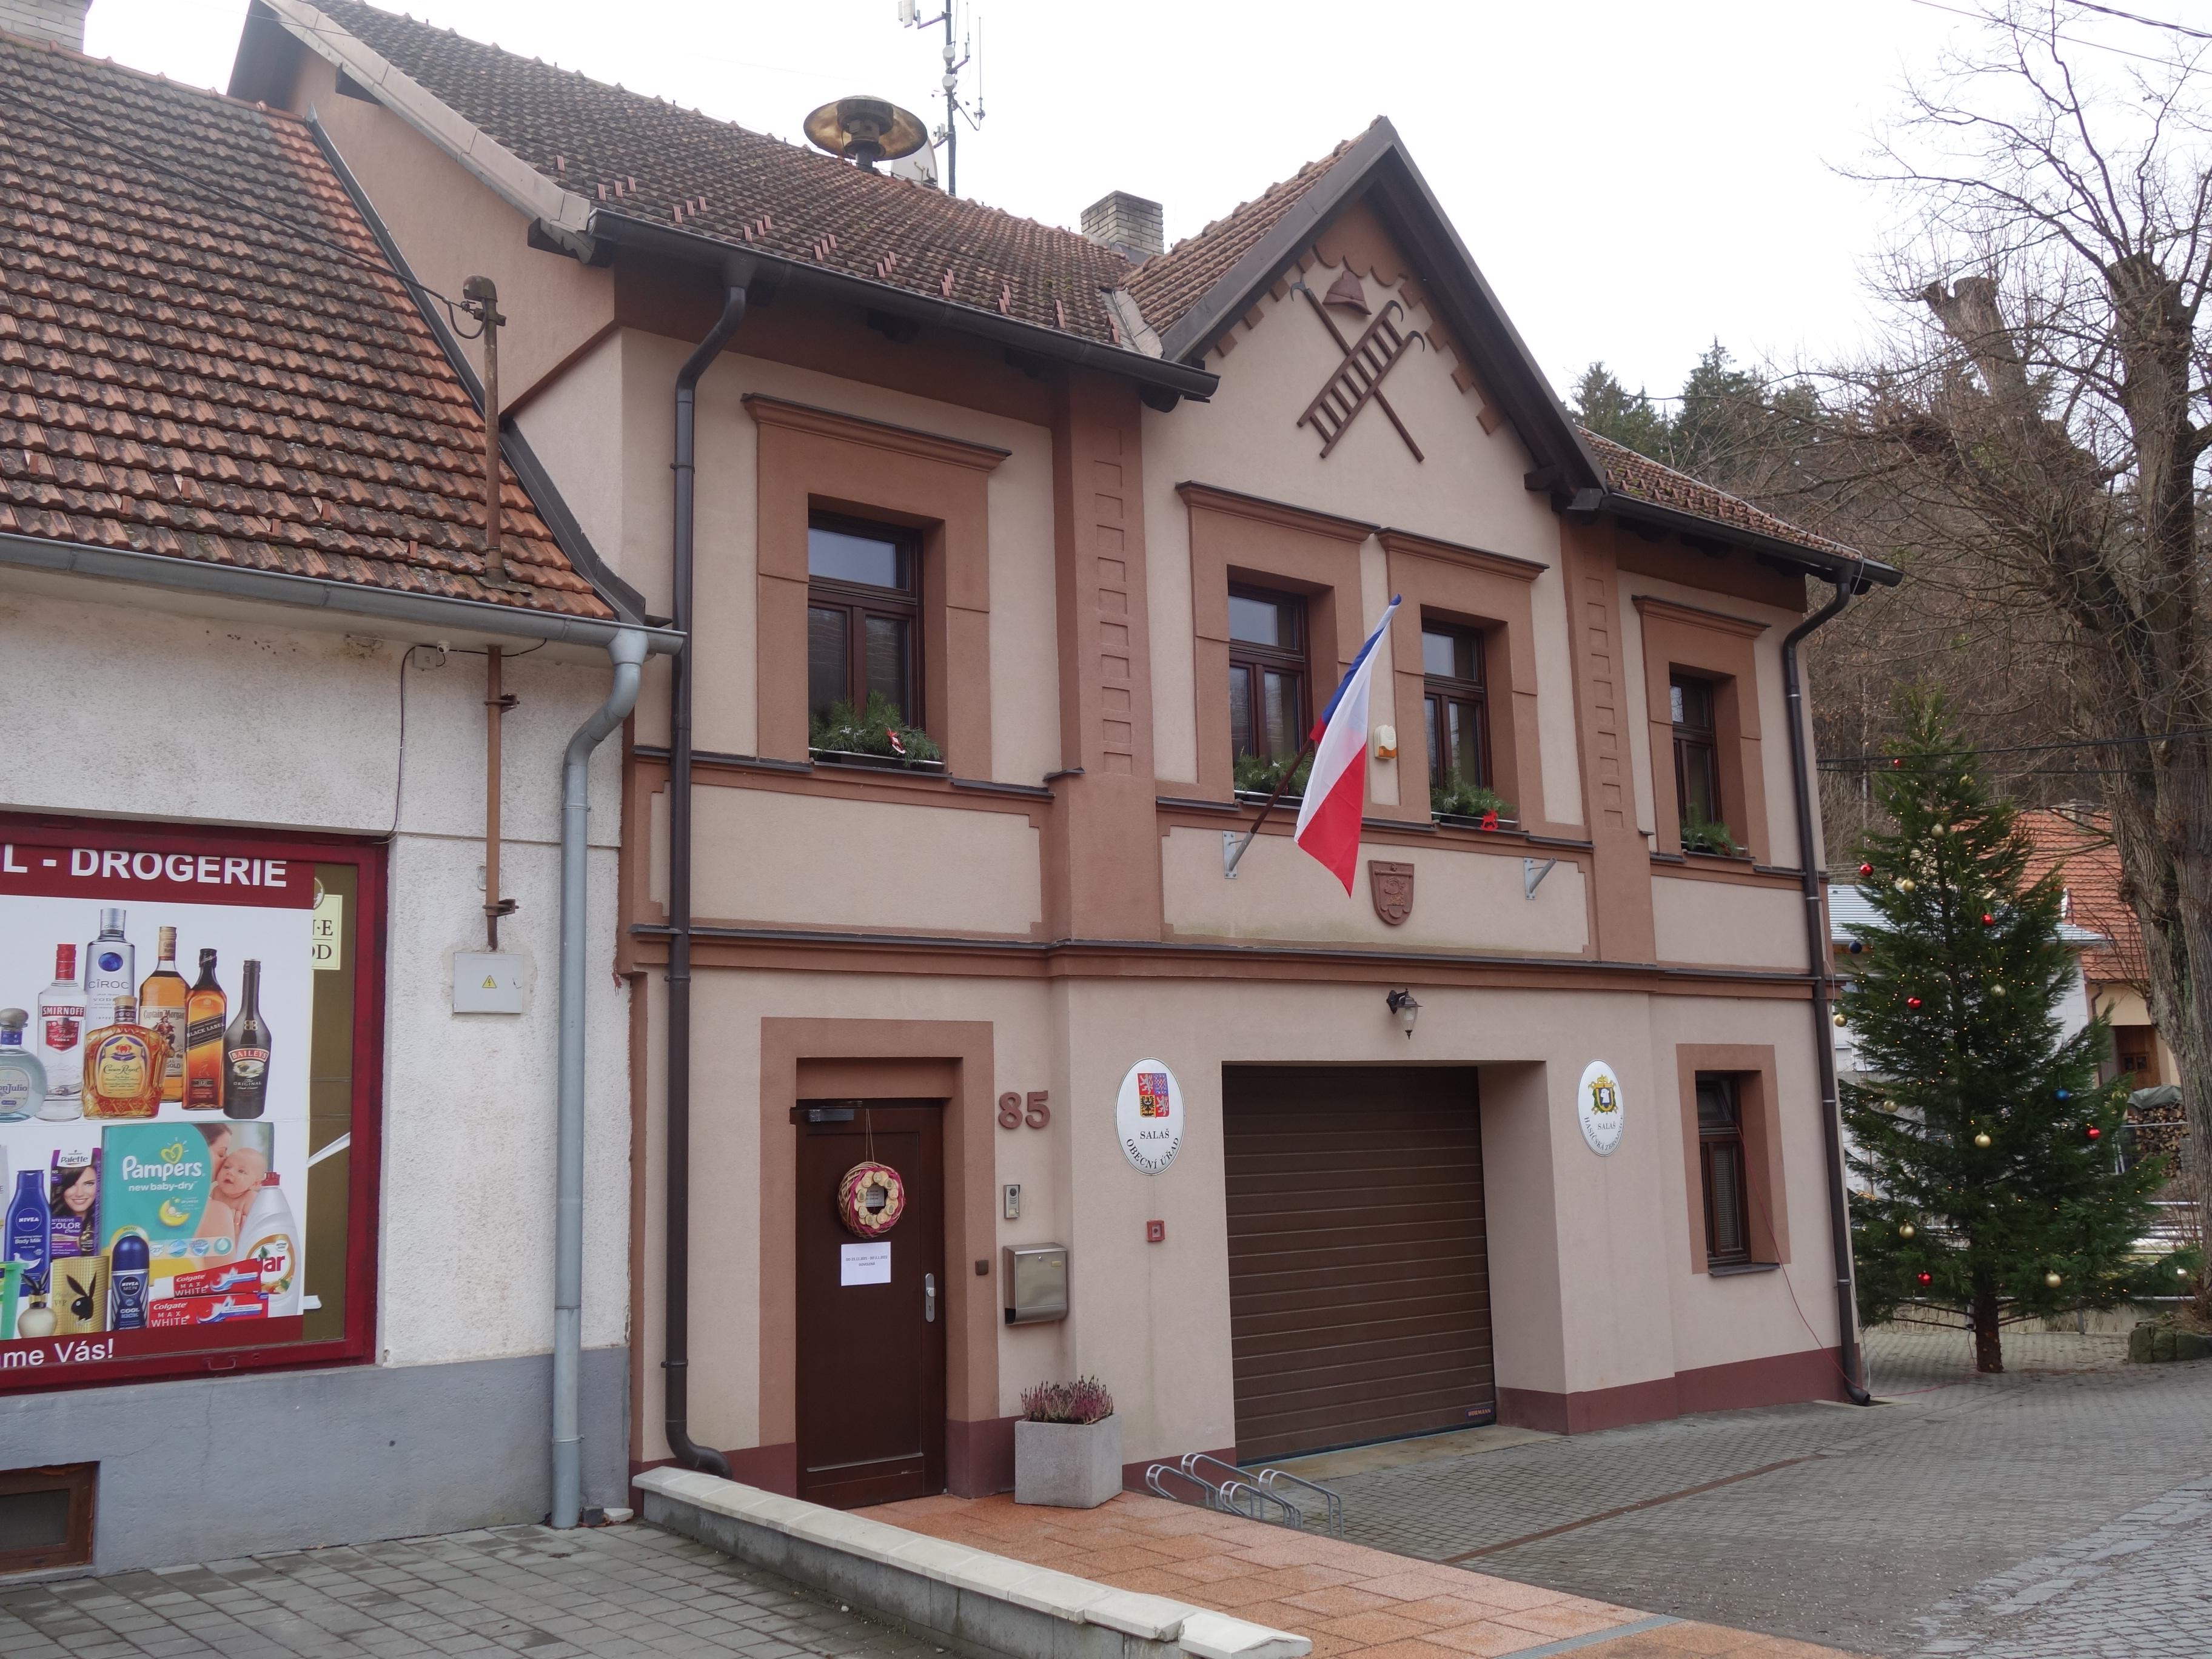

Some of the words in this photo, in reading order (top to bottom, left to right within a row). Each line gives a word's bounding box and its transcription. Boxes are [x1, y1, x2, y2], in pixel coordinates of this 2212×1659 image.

[4, 844, 28, 873] L
[71, 848, 287, 887] DROGERIE
[42, 1007, 84, 1016] SMIRNOFF
[143, 1010, 164, 1020] Captain
[187, 1028, 206, 1037] BLACK
[206, 1022, 225, 1031] LABEL
[232, 1050, 267, 1059] BAILEYS
[998, 1090, 1051, 1129] 85
[1597, 1121, 1616, 1130] SALAŠ
[1139, 1128, 1170, 1139] SALAŠ
[1126, 1138, 1157, 1170] OBECNÍ
[1160, 1137, 1179, 1166] ÚŘAD
[122, 1155, 202, 1182] Pampers
[150, 1181, 195, 1191] baby-dry
[263, 1255, 285, 1273] ar
[176, 1273, 206, 1282] Colgate
[175, 1287, 207, 1296] WHITE
[153, 1302, 187, 1311] Colgate
[152, 1316, 188, 1328] WHITE
[3, 1349, 45, 1369] me
[55, 1338, 114, 1363] Vás!
